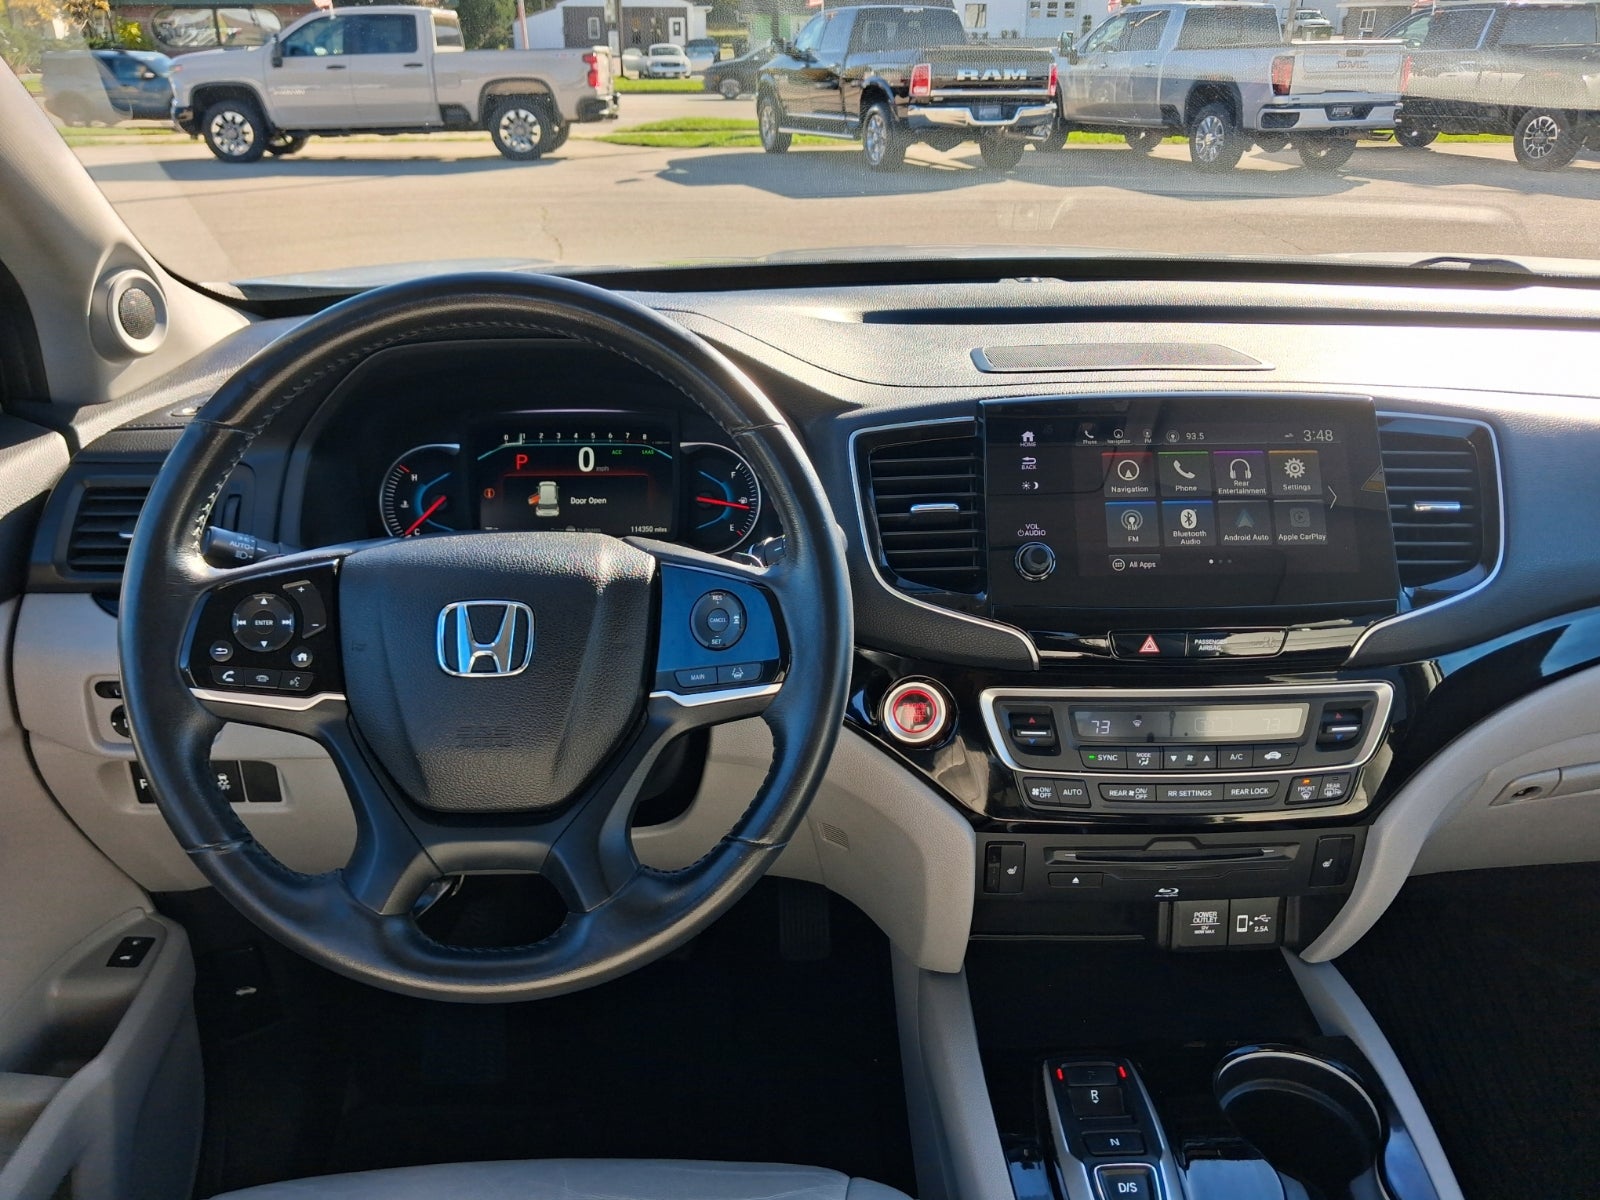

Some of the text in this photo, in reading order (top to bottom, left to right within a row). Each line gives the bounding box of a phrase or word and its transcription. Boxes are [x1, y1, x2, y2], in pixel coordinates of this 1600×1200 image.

[1337, 60, 1369, 70] GMC
[957, 68, 1028, 81] RAM
[1185, 432, 1205, 440] 93.5
[1303, 429, 1334, 442] 3:48
[515, 453, 529, 470] P
[577, 446, 610, 473] 0 mph
[410, 473, 418, 482] H
[730, 471, 736, 479] F
[1111, 486, 1149, 494] Navigation
[570, 496, 607, 505] Door Open
[414, 528, 421, 536] C
[630, 525, 653, 533] 114350
[729, 524, 735, 532] E
[1278, 533, 1327, 542] Apple CarPlay
[229, 541, 251, 549] AUTO
[1139, 561, 1156, 569] Apps
[690, 673, 705, 681] MAIN
[1091, 719, 1111, 735] 73
[1229, 753, 1243, 761] A/C
[1179, 789, 1212, 797] SETTINGS
[1091, 1089, 1099, 1100] R
[1110, 1137, 1121, 1147] N
[1117, 1182, 1138, 1193] D/S
